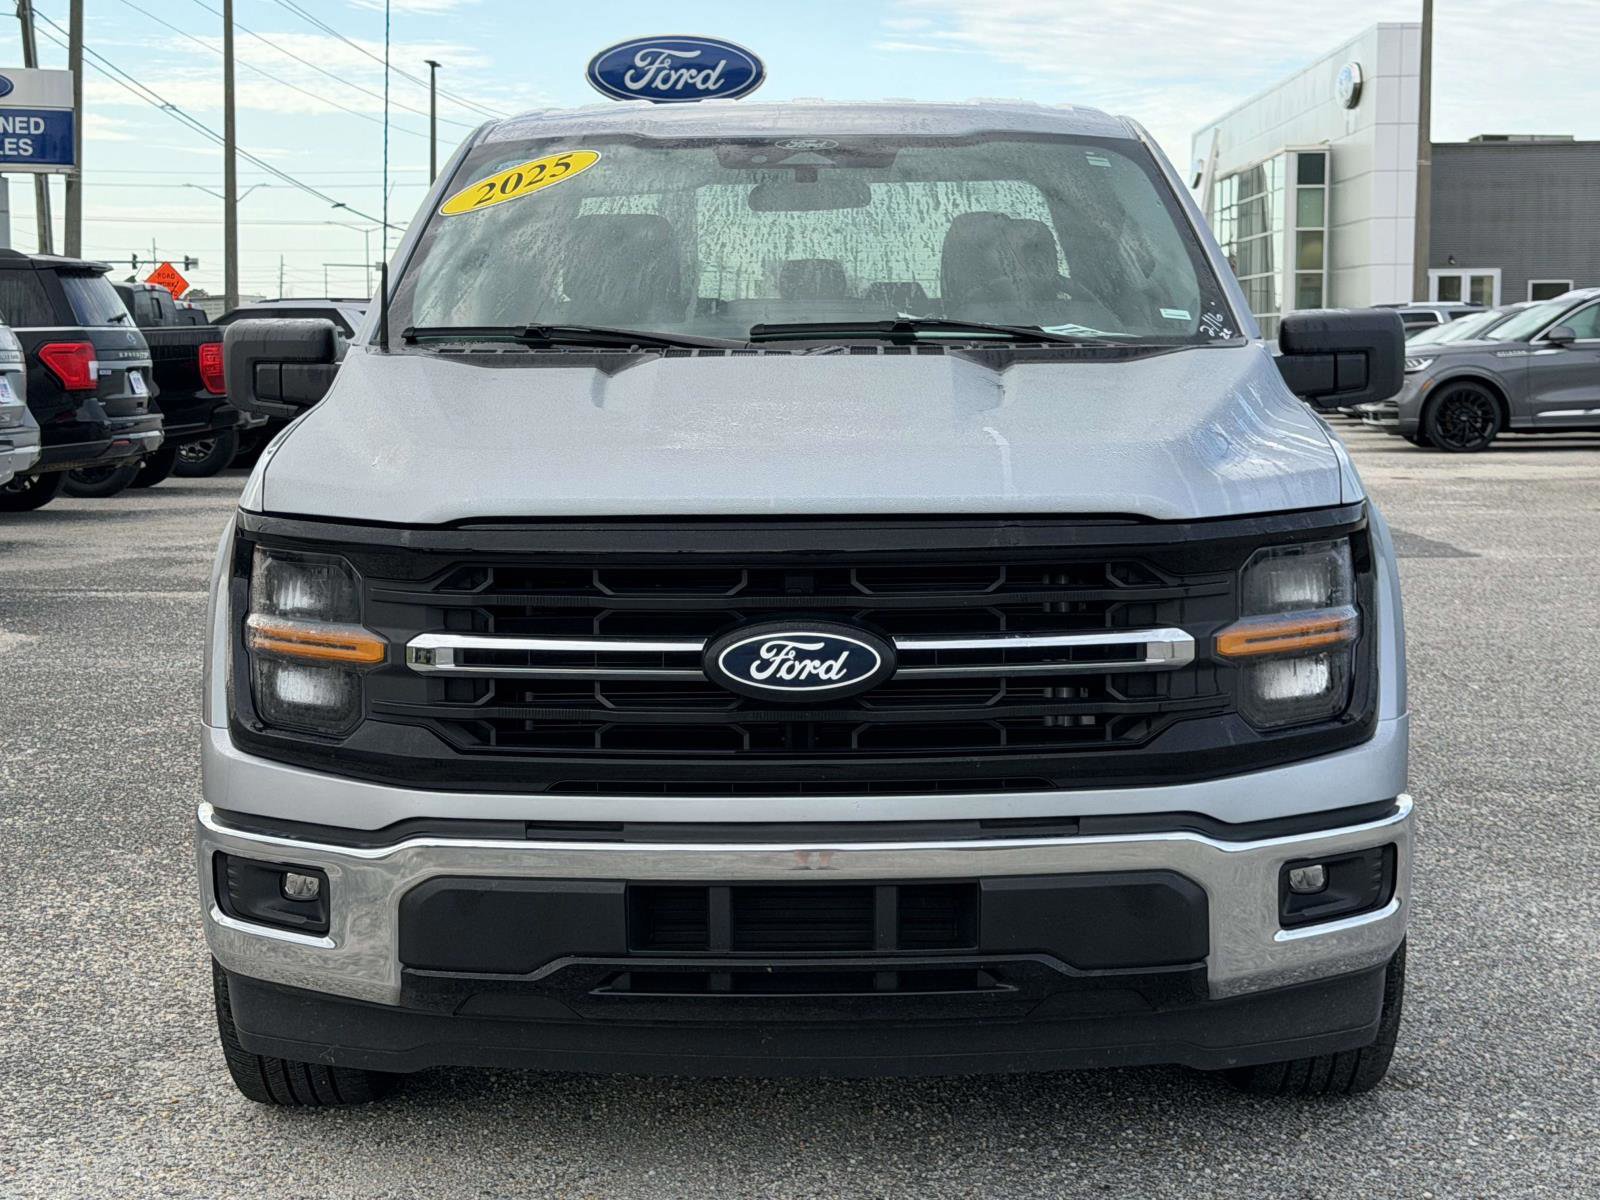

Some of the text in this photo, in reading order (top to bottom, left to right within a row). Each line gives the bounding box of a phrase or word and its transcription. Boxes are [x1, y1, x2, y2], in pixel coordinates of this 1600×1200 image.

[624, 48, 727, 90] Ford
[0, 116, 45, 135] NED
[0, 138, 33, 156] ES
[473, 154, 573, 207] 2025
[749, 640, 850, 680] Ford
